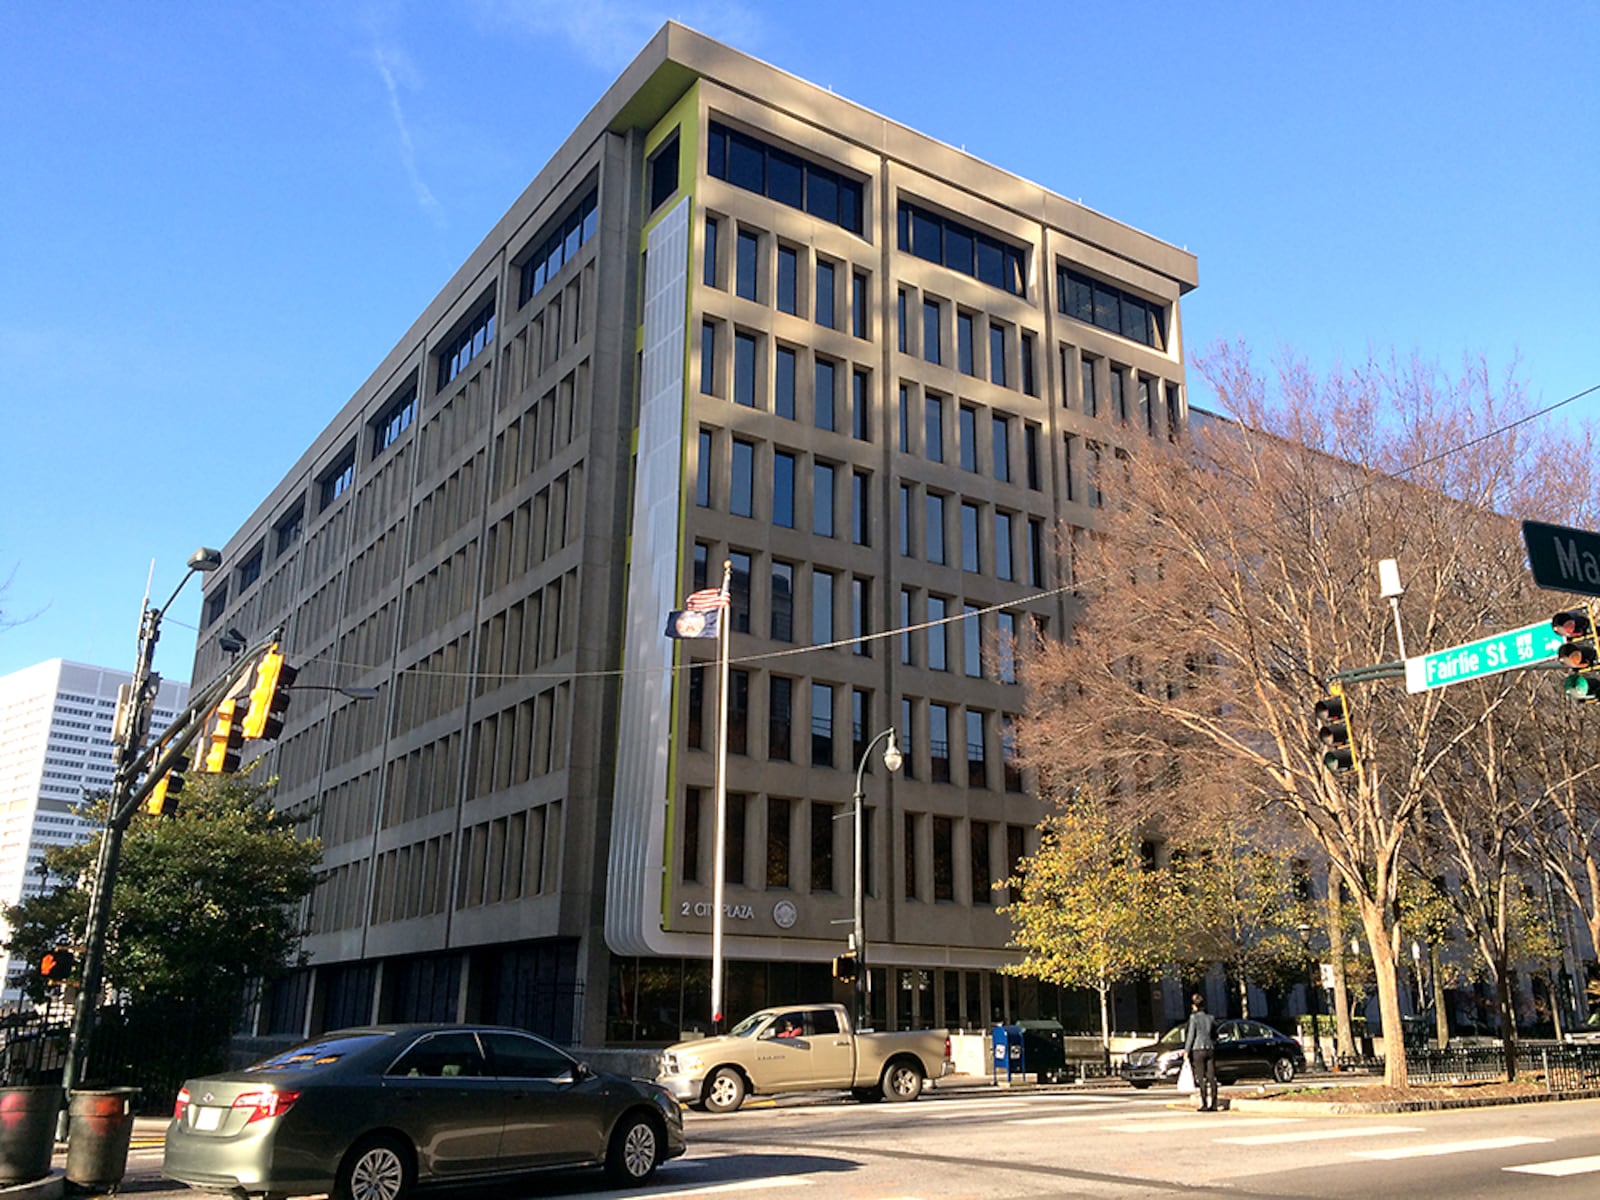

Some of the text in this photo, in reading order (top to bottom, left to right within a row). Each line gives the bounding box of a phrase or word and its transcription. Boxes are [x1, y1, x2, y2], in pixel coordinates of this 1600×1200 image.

[1553, 536, 1600, 585] Ma
[1426, 650, 1480, 683] Fairlie
[1485, 641, 1509, 667] St
[1517, 646, 1534, 660] 50
[681, 901, 755, 919] 2 CIT PLAZA
